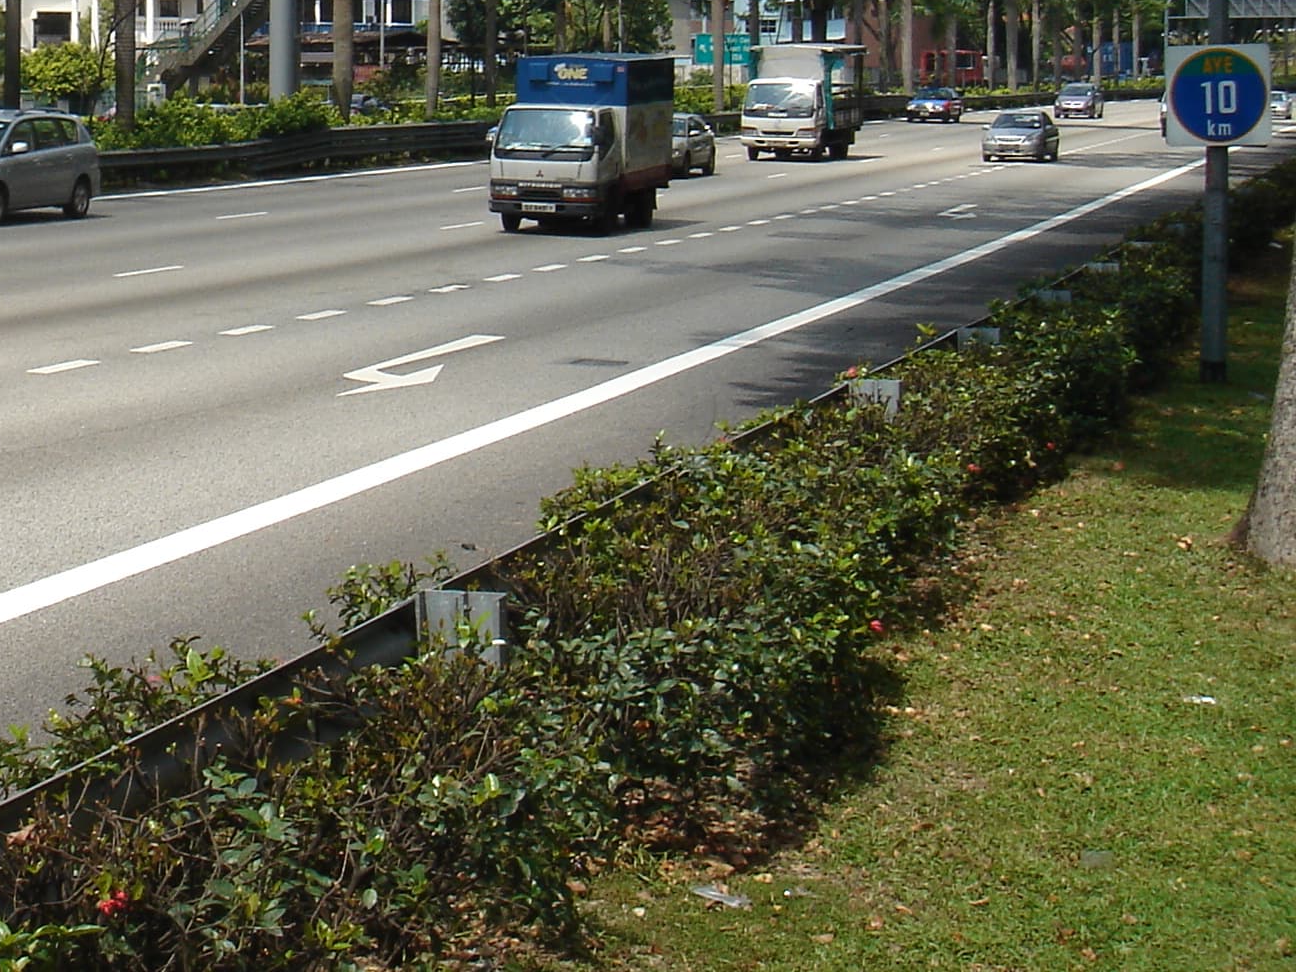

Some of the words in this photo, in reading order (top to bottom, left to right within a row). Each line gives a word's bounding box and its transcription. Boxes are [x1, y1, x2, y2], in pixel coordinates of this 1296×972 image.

[1202, 57, 1233, 74] AYE
[1200, 80, 1237, 115] 10
[1207, 119, 1232, 137] km
